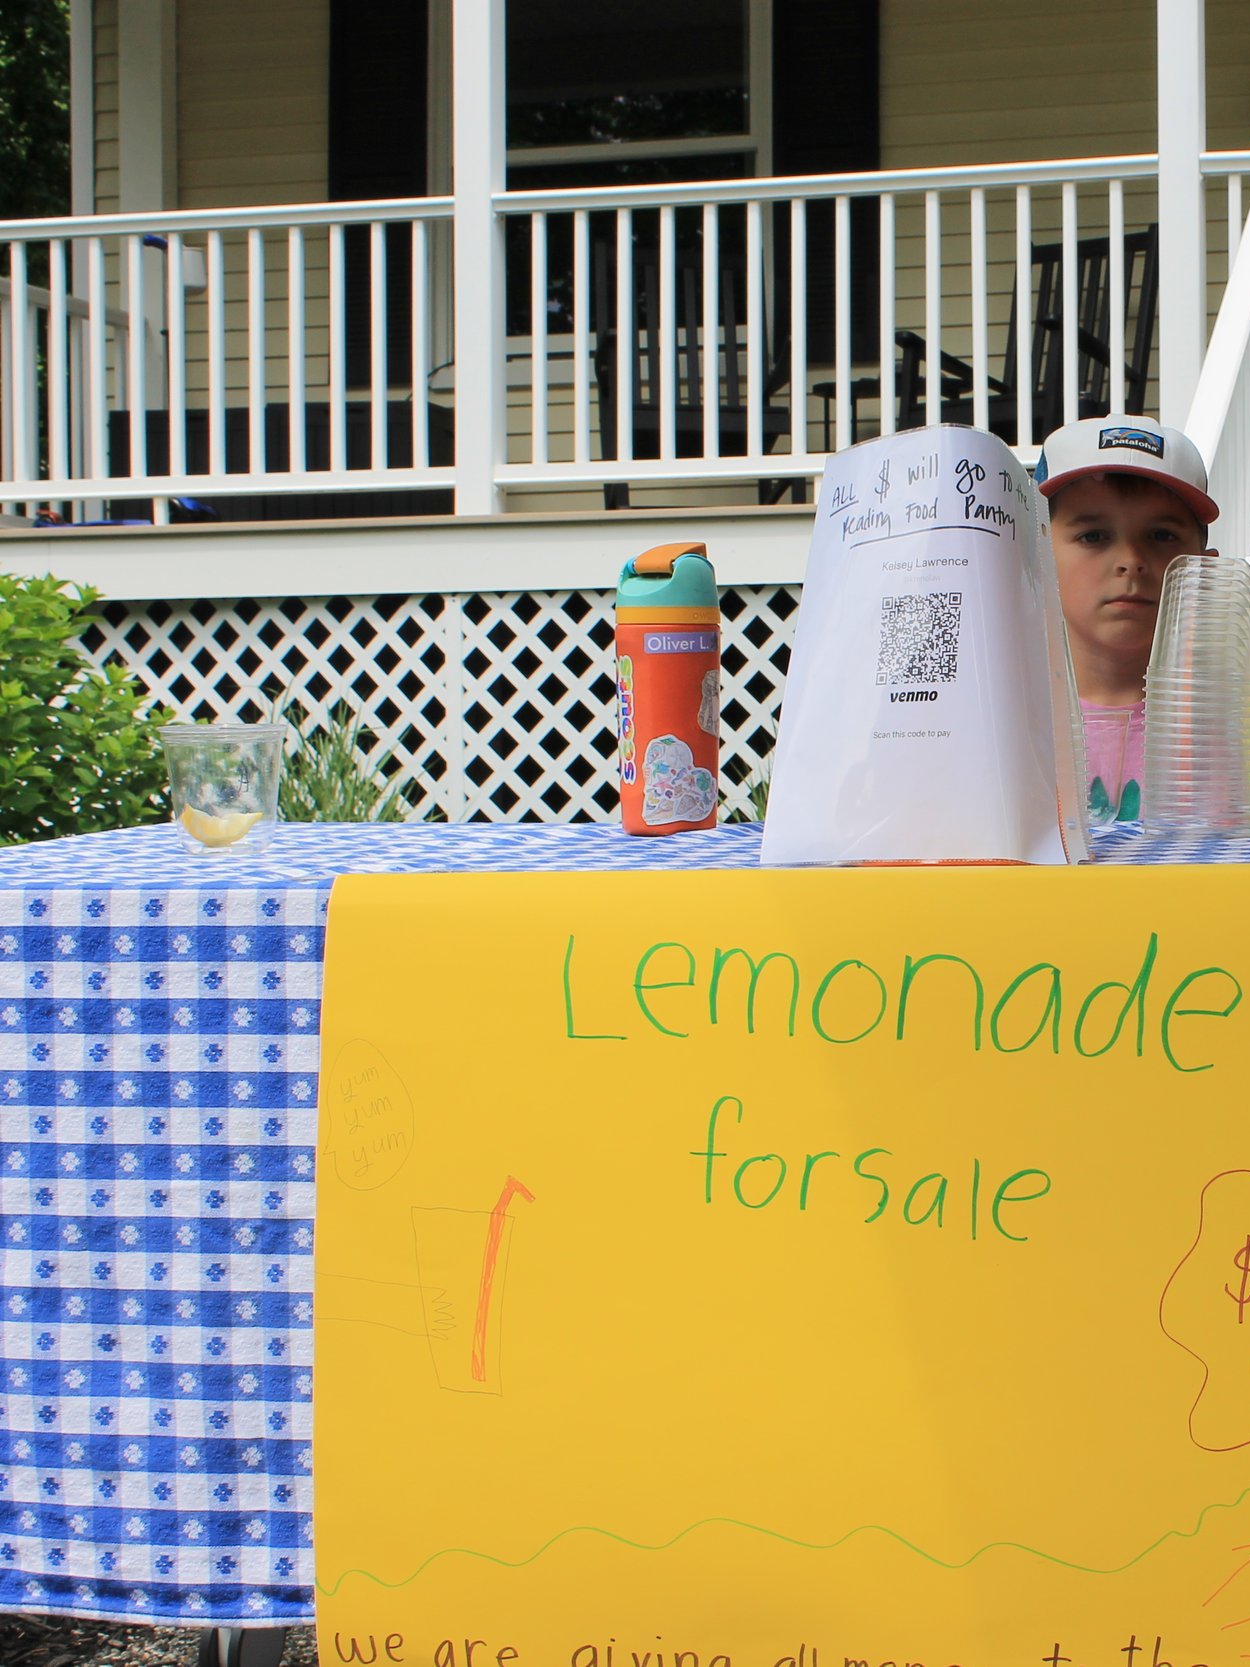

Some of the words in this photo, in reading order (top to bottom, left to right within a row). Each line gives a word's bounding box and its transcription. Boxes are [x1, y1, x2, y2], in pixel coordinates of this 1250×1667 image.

[831, 483, 857, 508] ALL
[907, 453, 939, 486] will
[955, 458, 986, 495] go
[905, 497, 939, 524] Food
[964, 494, 1017, 541] Pantry
[882, 559, 914, 572] Kelsey
[915, 557, 969, 569] Lawrence
[647, 635, 696, 651] Oliver
[699, 635, 710, 650] L.
[890, 690, 938, 703] venmo
[873, 731, 891, 740] Scan
[892, 730, 906, 739] this
[907, 729, 926, 738] code
[927, 730, 936, 738] to
[937, 730, 951, 740] pay
[563, 932, 1243, 1072] Lemonade
[339, 1065, 380, 1103] yum
[343, 1095, 393, 1135] yum
[352, 1130, 408, 1177] yum
[335, 1632, 404, 1665] we
[434, 1638, 519, 1667] are
[570, 1635, 732, 1667] ivin
[1120, 1634, 1211, 1667] th
